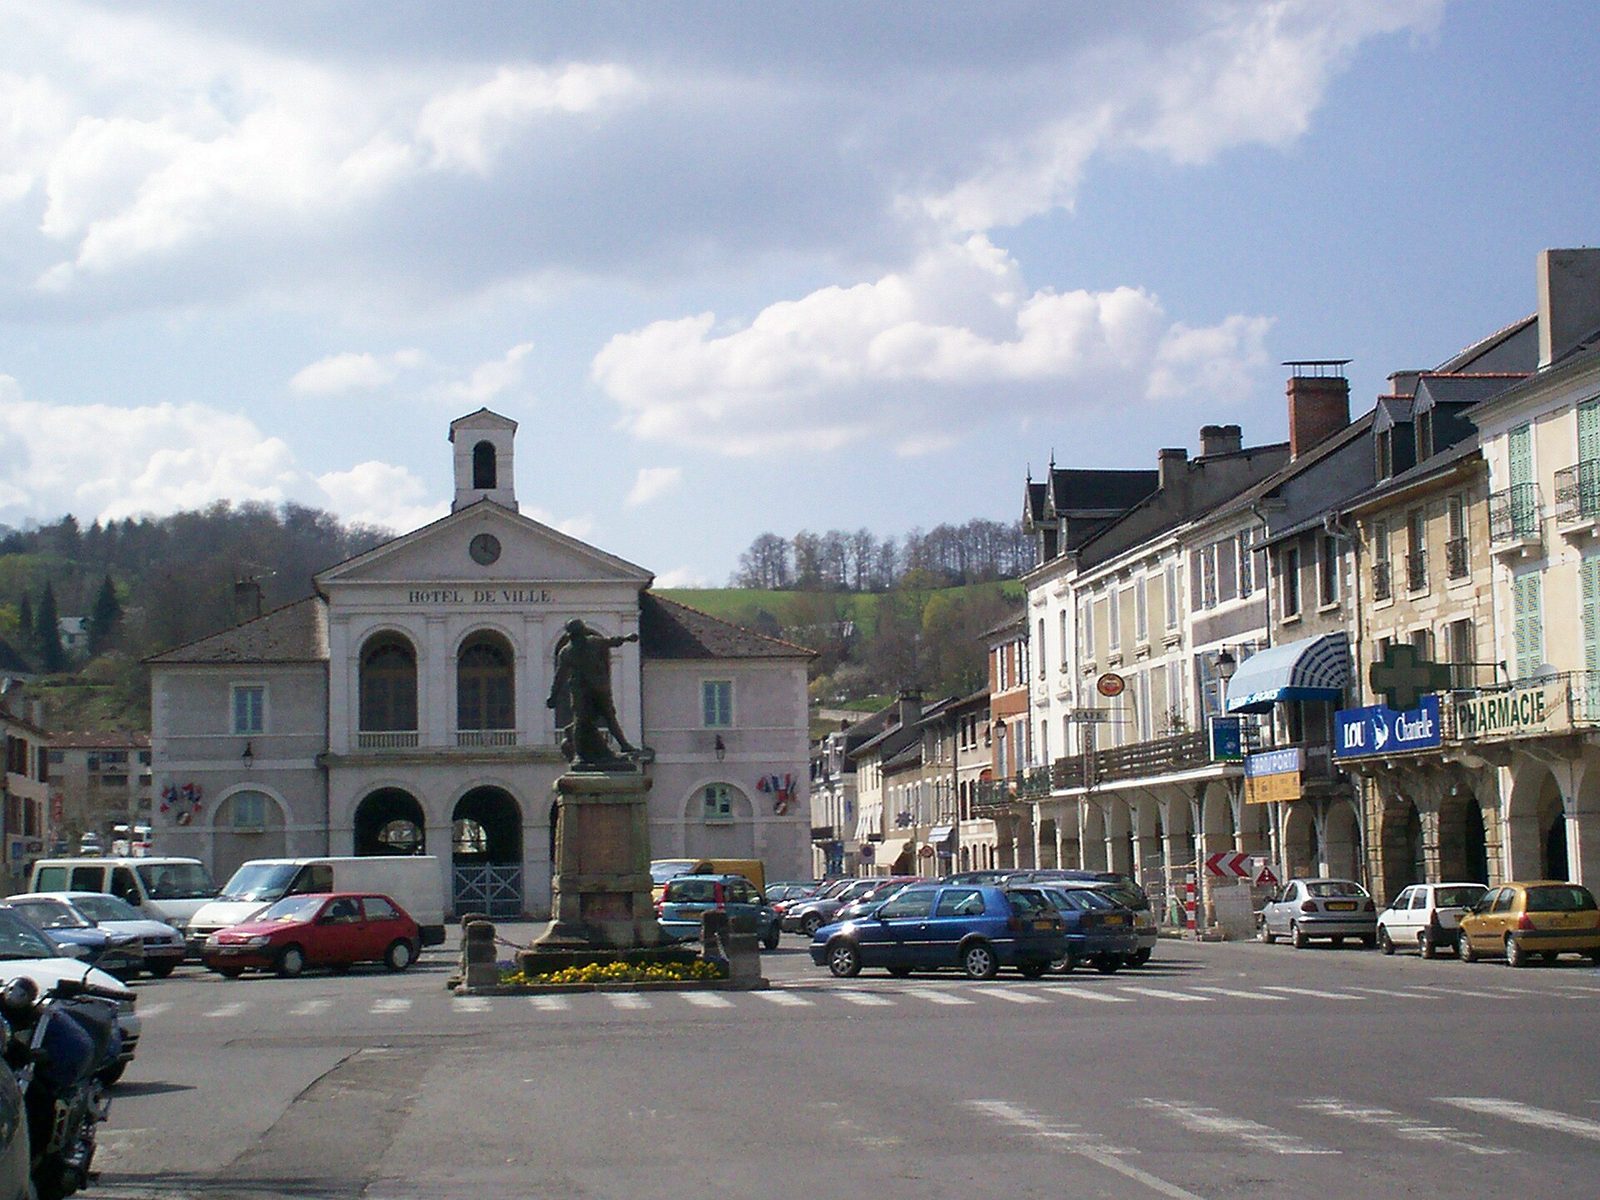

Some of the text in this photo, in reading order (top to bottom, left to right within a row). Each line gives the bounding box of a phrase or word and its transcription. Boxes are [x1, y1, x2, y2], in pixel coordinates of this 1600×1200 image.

[408, 590, 464, 603] HOTEL
[474, 590, 496, 603] DE
[1343, 708, 1433, 749] LOU Chantelle
[1459, 690, 1546, 734] PHARMACIE
